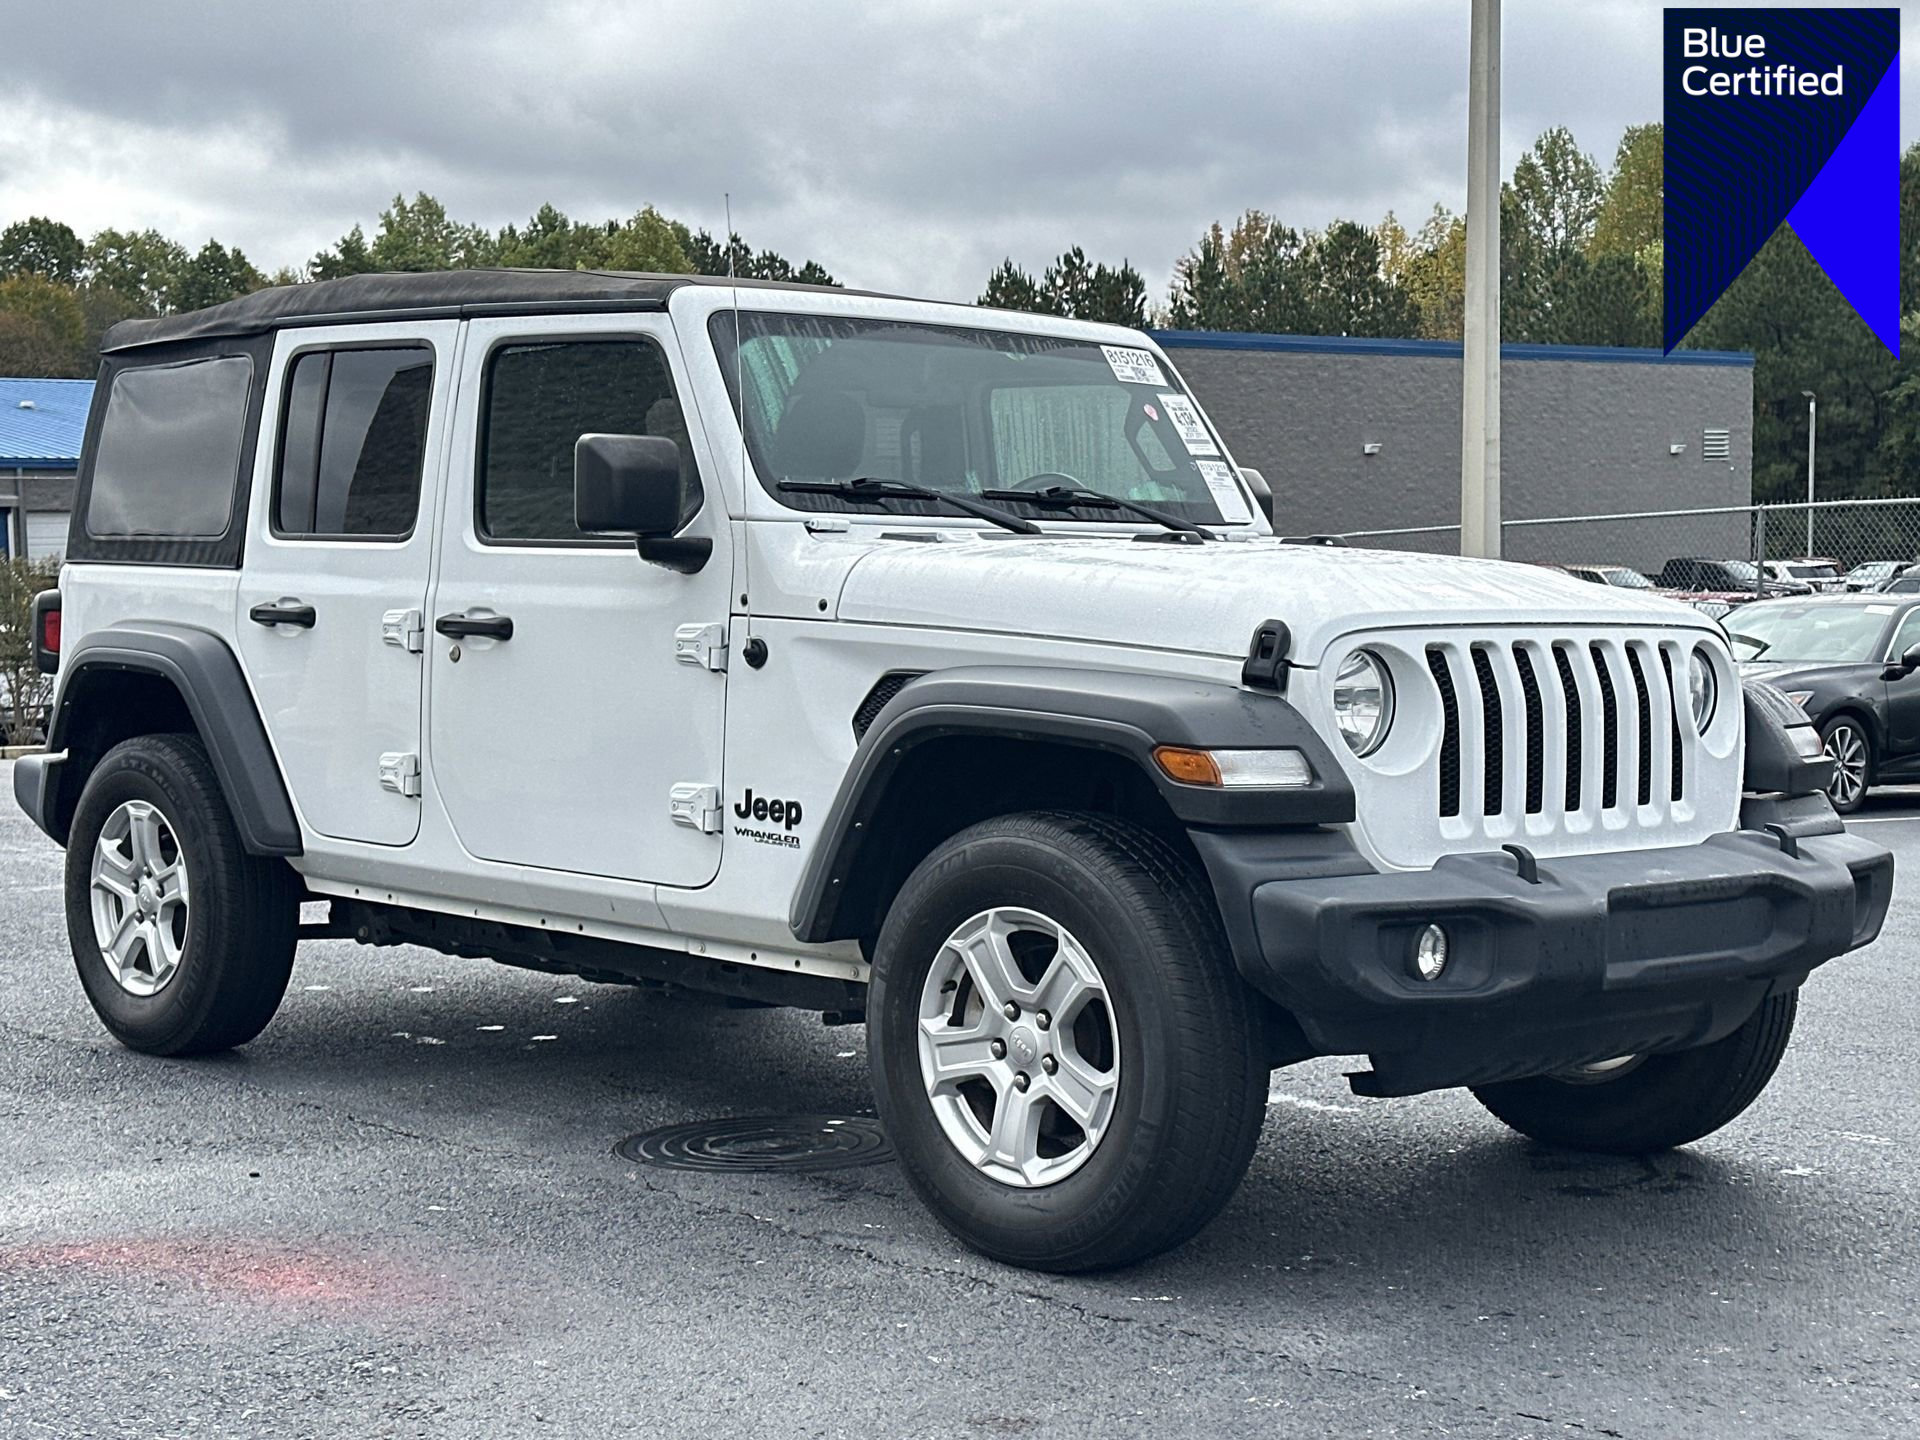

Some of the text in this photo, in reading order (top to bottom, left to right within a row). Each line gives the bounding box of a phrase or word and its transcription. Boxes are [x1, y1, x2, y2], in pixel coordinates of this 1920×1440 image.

[1106, 349, 1155, 368] 8151216
[734, 788, 802, 831] Jeep
[734, 826, 800, 845] WRANGLER
